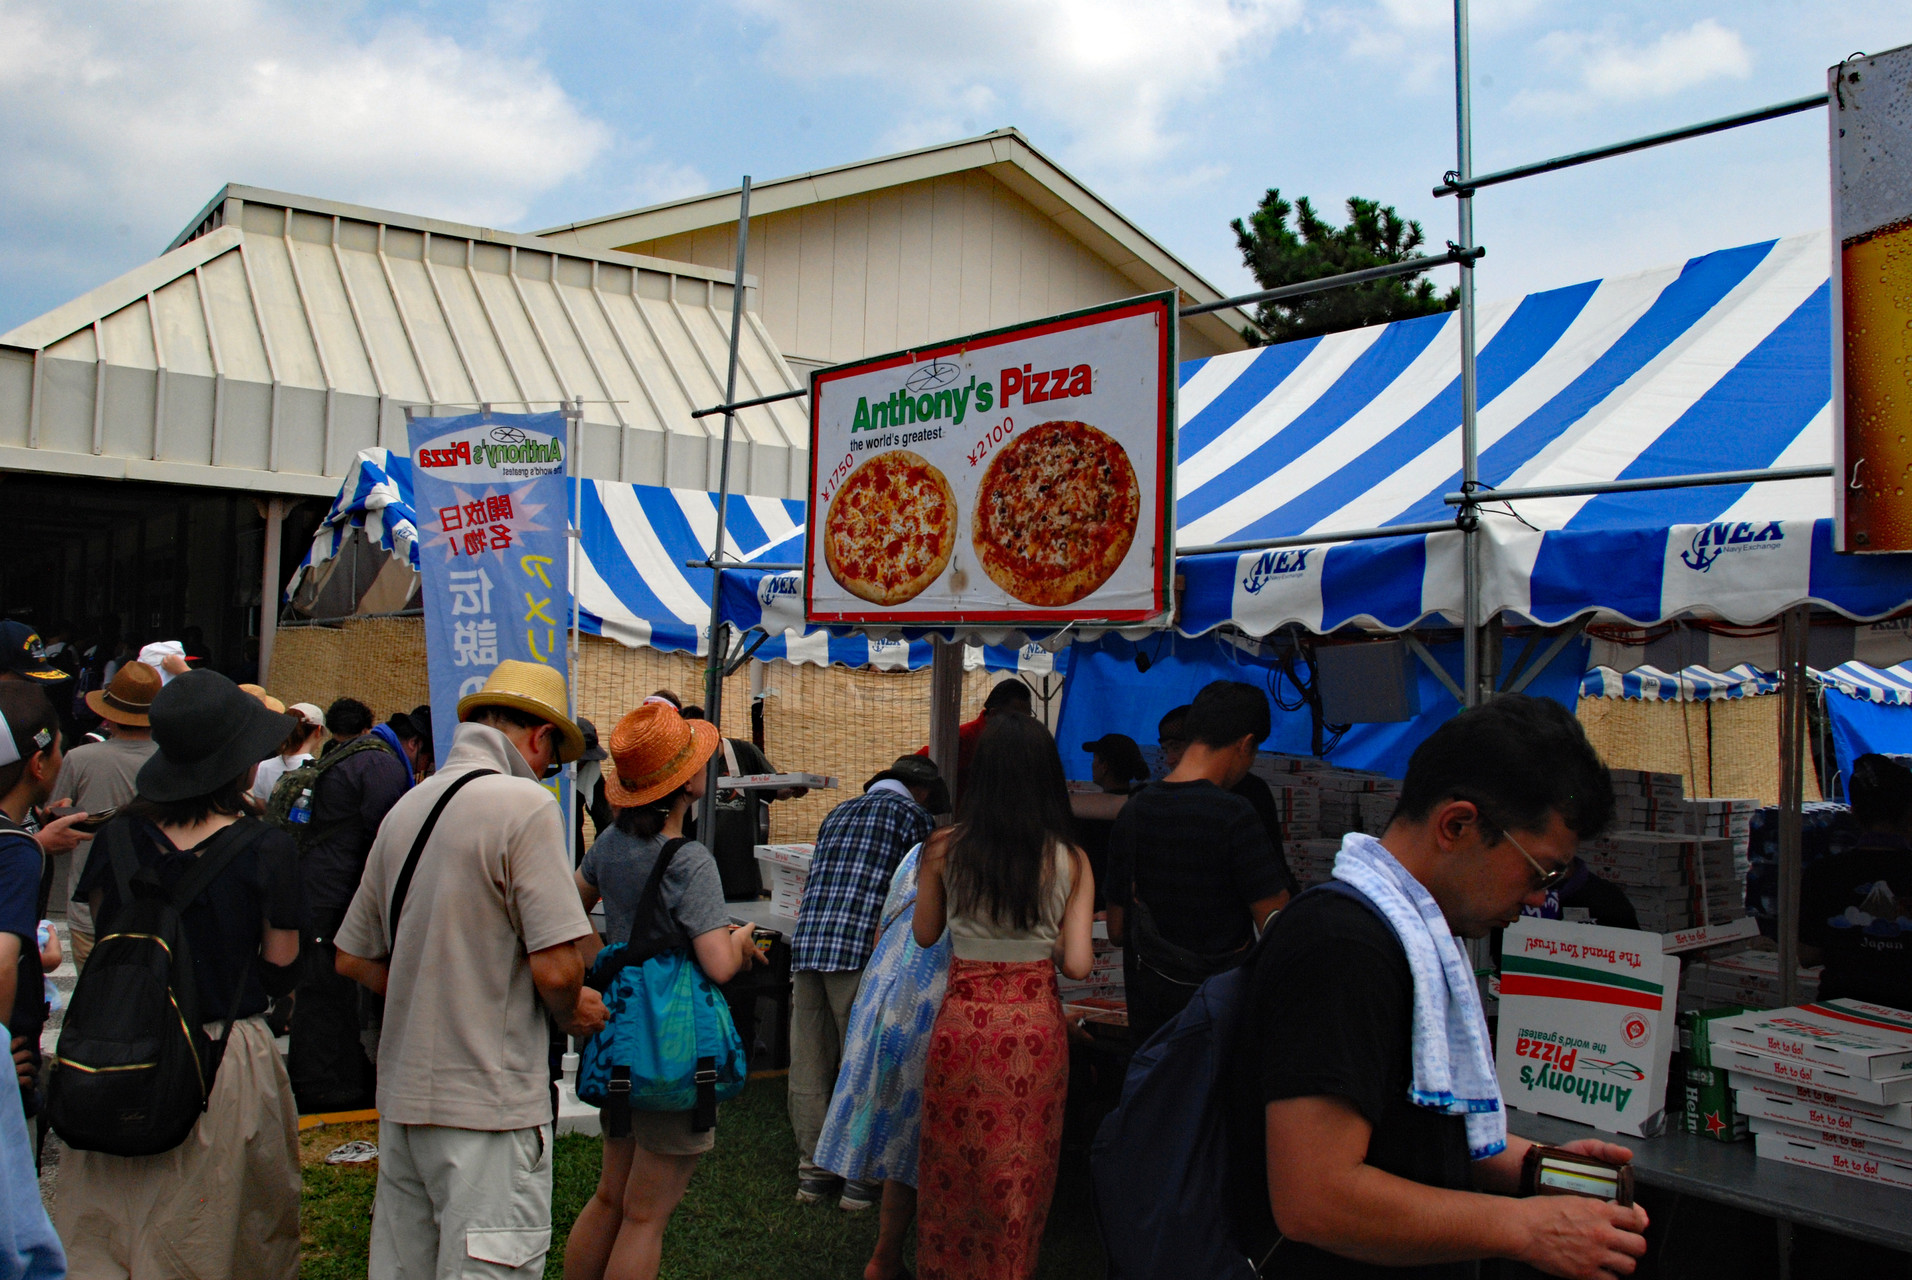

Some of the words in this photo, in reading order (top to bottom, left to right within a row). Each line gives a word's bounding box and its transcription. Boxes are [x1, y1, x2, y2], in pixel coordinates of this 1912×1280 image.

[851, 375, 994, 434] Anthony's
[1000, 363, 1092, 409] Pizza
[850, 437, 864, 452] the
[865, 432, 900, 450] world's
[901, 427, 943, 448] greatest
[966, 416, 1015, 468] ¥2100
[821, 453, 855, 503] ¥1750
[1698, 520, 1786, 547] NEX
[1723, 546, 1743, 554] Navy
[1743, 543, 1781, 551] Exchange
[1255, 547, 1317, 575] NEX
[768, 576, 799, 594] NEX
[1525, 937, 1558, 956] Trust!
[1560, 942, 1580, 958] You
[1860, 936, 1904, 952] Japan
[1582, 945, 1616, 963] Brand
[1618, 951, 1642, 968] The
[1518, 1028, 1558, 1045] greatest!
[1558, 1035, 1590, 1050] world's
[1516, 1037, 1577, 1073] Pizza
[1593, 1041, 1607, 1054] the
[1767, 1037, 1781, 1050] Hot
[1782, 1041, 1791, 1052] to
[1791, 1042, 1804, 1055] Go!
[1774, 1062, 1788, 1075] Hot
[1790, 1066, 1799, 1078] to
[1799, 1068, 1813, 1080] Go!
[1520, 1063, 1633, 1112] Anthony's
[1796, 1085, 1811, 1098] Hot
[1813, 1090, 1822, 1100] to
[1823, 1092, 1837, 1103] Go!
[1684, 1085, 1700, 1135] Hein
[1809, 1110, 1825, 1124] Hot
[1827, 1114, 1837, 1125] to
[1838, 1115, 1853, 1129] Go!
[1822, 1131, 1838, 1143] Hot
[1840, 1135, 1849, 1145] to
[1850, 1138, 1865, 1149] Go!
[1833, 1155, 1850, 1169] Hot
[1851, 1160, 1862, 1171] to
[1863, 1161, 1879, 1175] Go!
